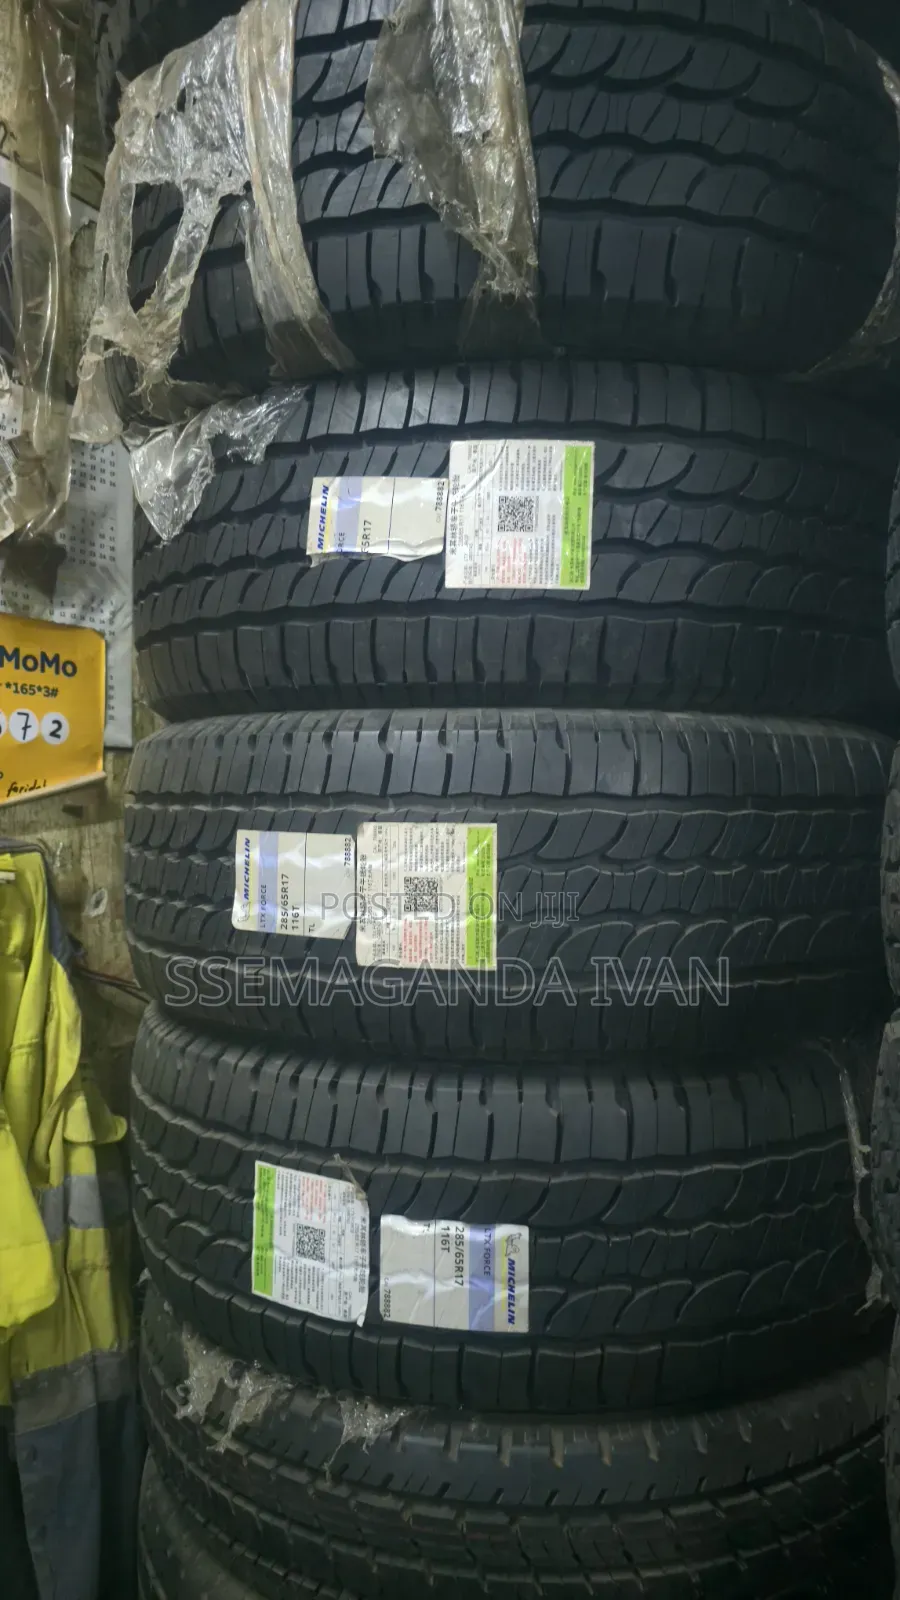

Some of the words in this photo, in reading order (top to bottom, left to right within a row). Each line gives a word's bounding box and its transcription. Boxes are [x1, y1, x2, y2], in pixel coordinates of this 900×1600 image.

[435, 480, 445, 512] 788882
[317, 485, 329, 550] MICHELIN
[0, 645, 77, 678] MoMo
[343, 837, 352, 866] 788882
[243, 837, 252, 900] MICHELIN
[280, 873, 290, 930] 285/65R17
[291, 905, 300, 931] 116T
[440, 1226, 450, 1253] 116T
[483, 1227, 492, 1245] LTX
[454, 1226, 465, 1287] 285/65R17
[483, 1247, 491, 1277] FORCE
[383, 1289, 392, 1319] 788882
[507, 1258, 516, 1326] MICHELIN
